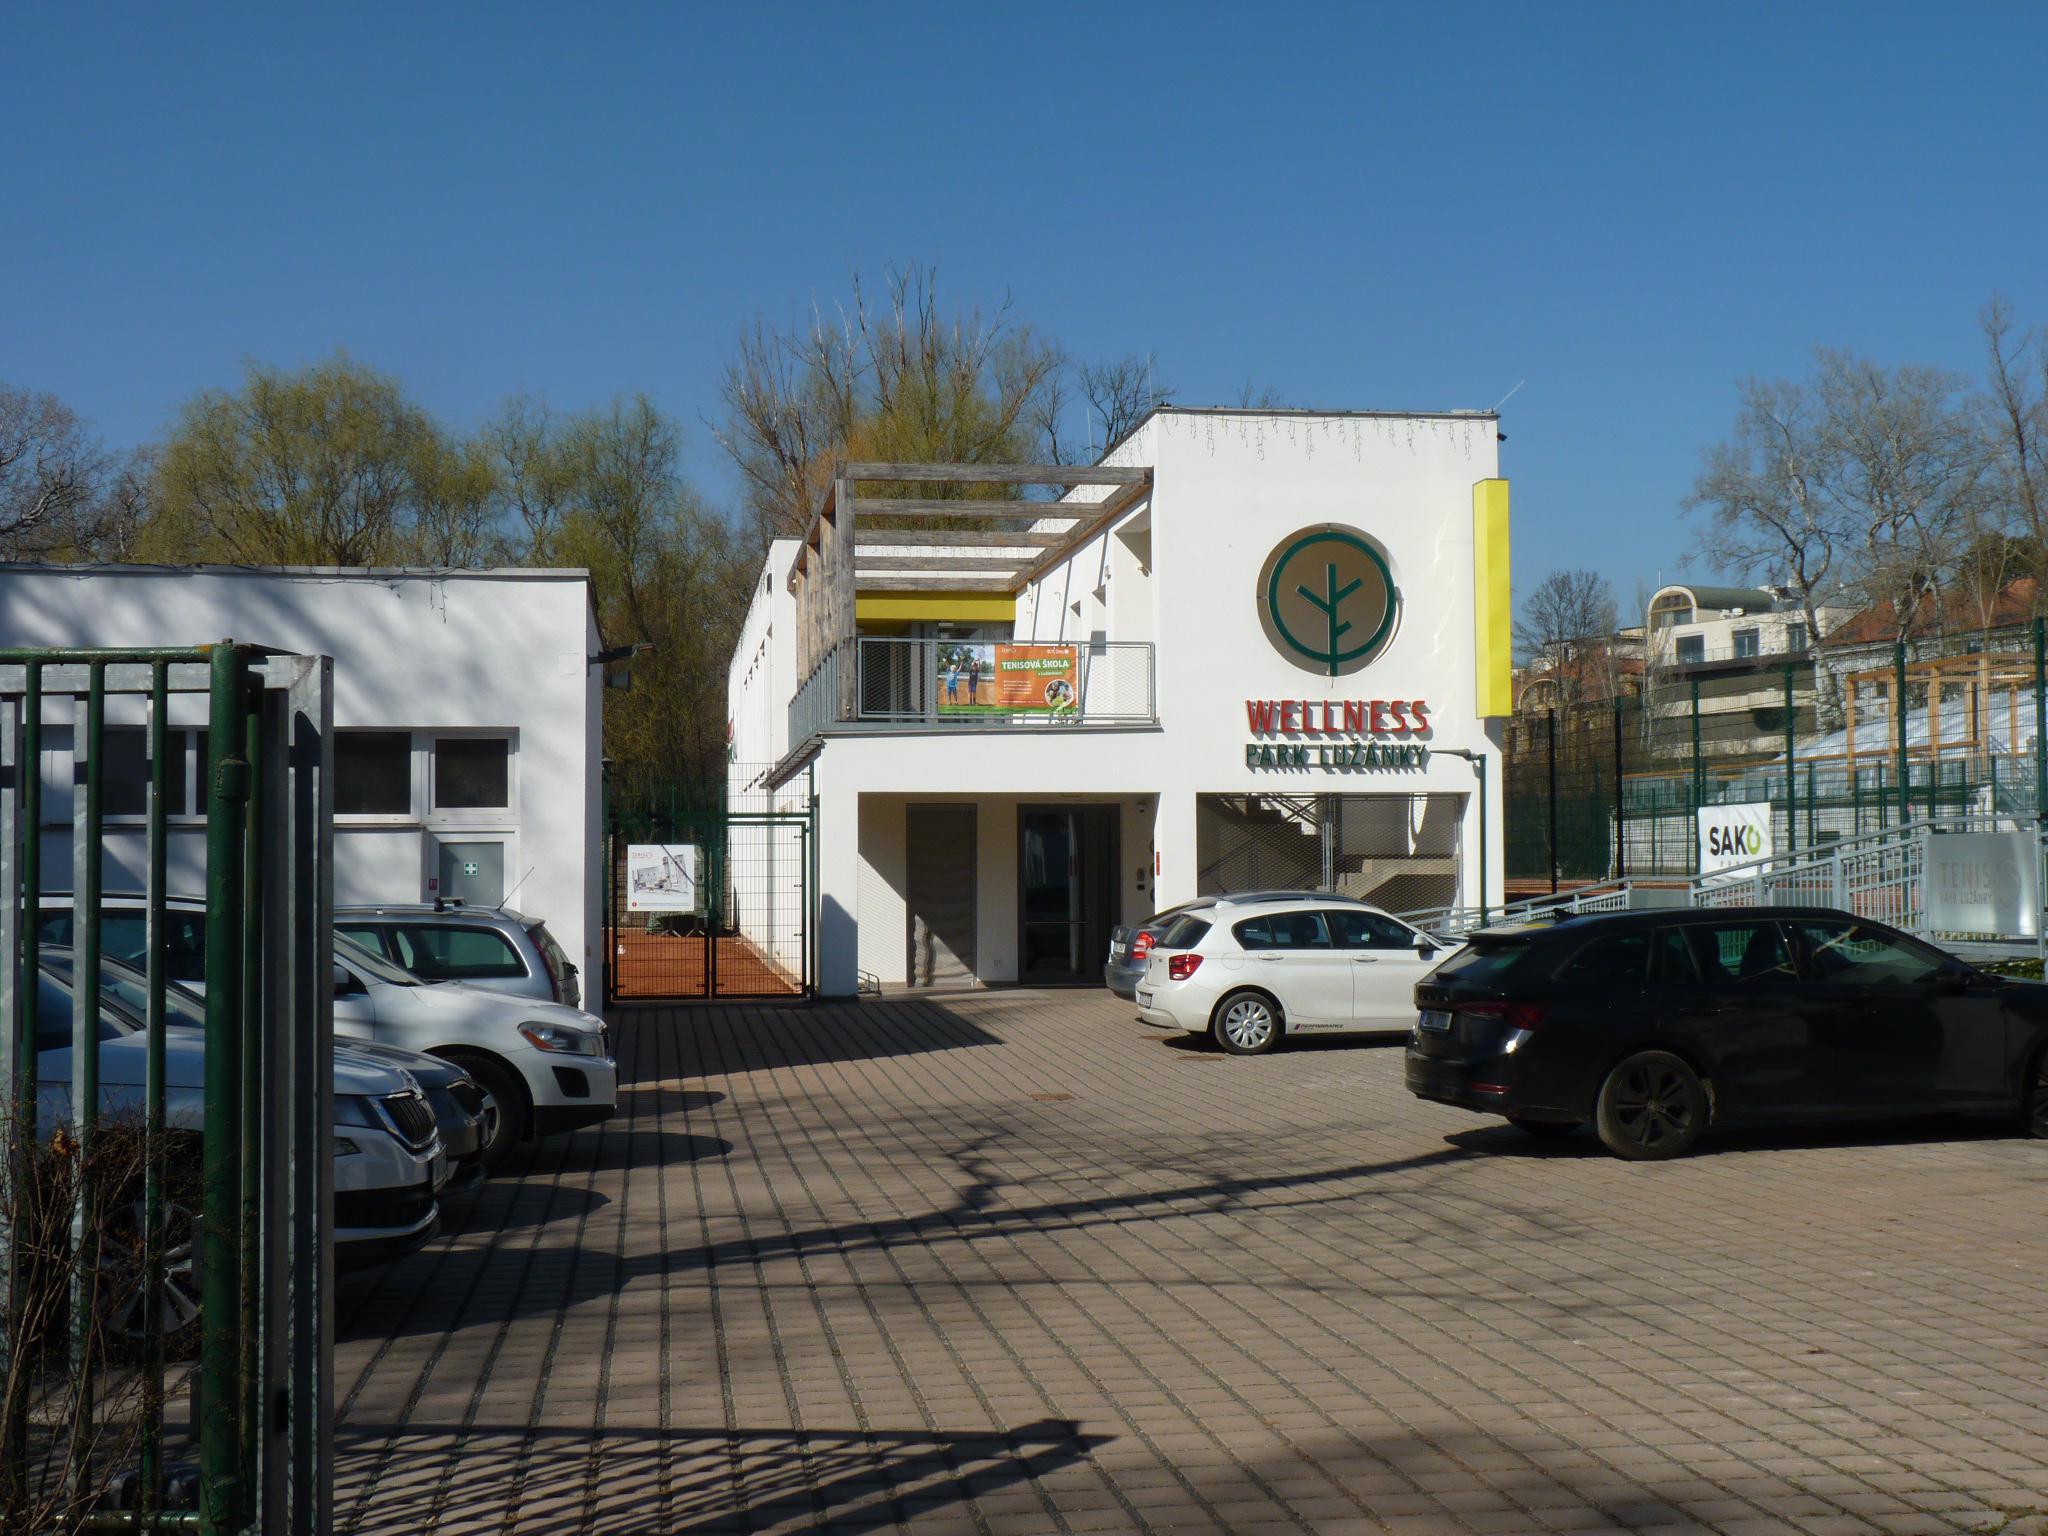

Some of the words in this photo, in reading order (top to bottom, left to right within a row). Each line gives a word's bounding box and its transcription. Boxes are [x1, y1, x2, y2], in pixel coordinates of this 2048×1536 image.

[1001, 659, 1041, 670] TENISOVÁ
[1042, 659, 1069, 669] ŠKOLA
[1246, 699, 1430, 733] WELLNESS
[1246, 743, 1306, 766] PARK
[1319, 736, 1426, 766] LUŽÁNKY
[1709, 824, 1761, 857] SAKO
